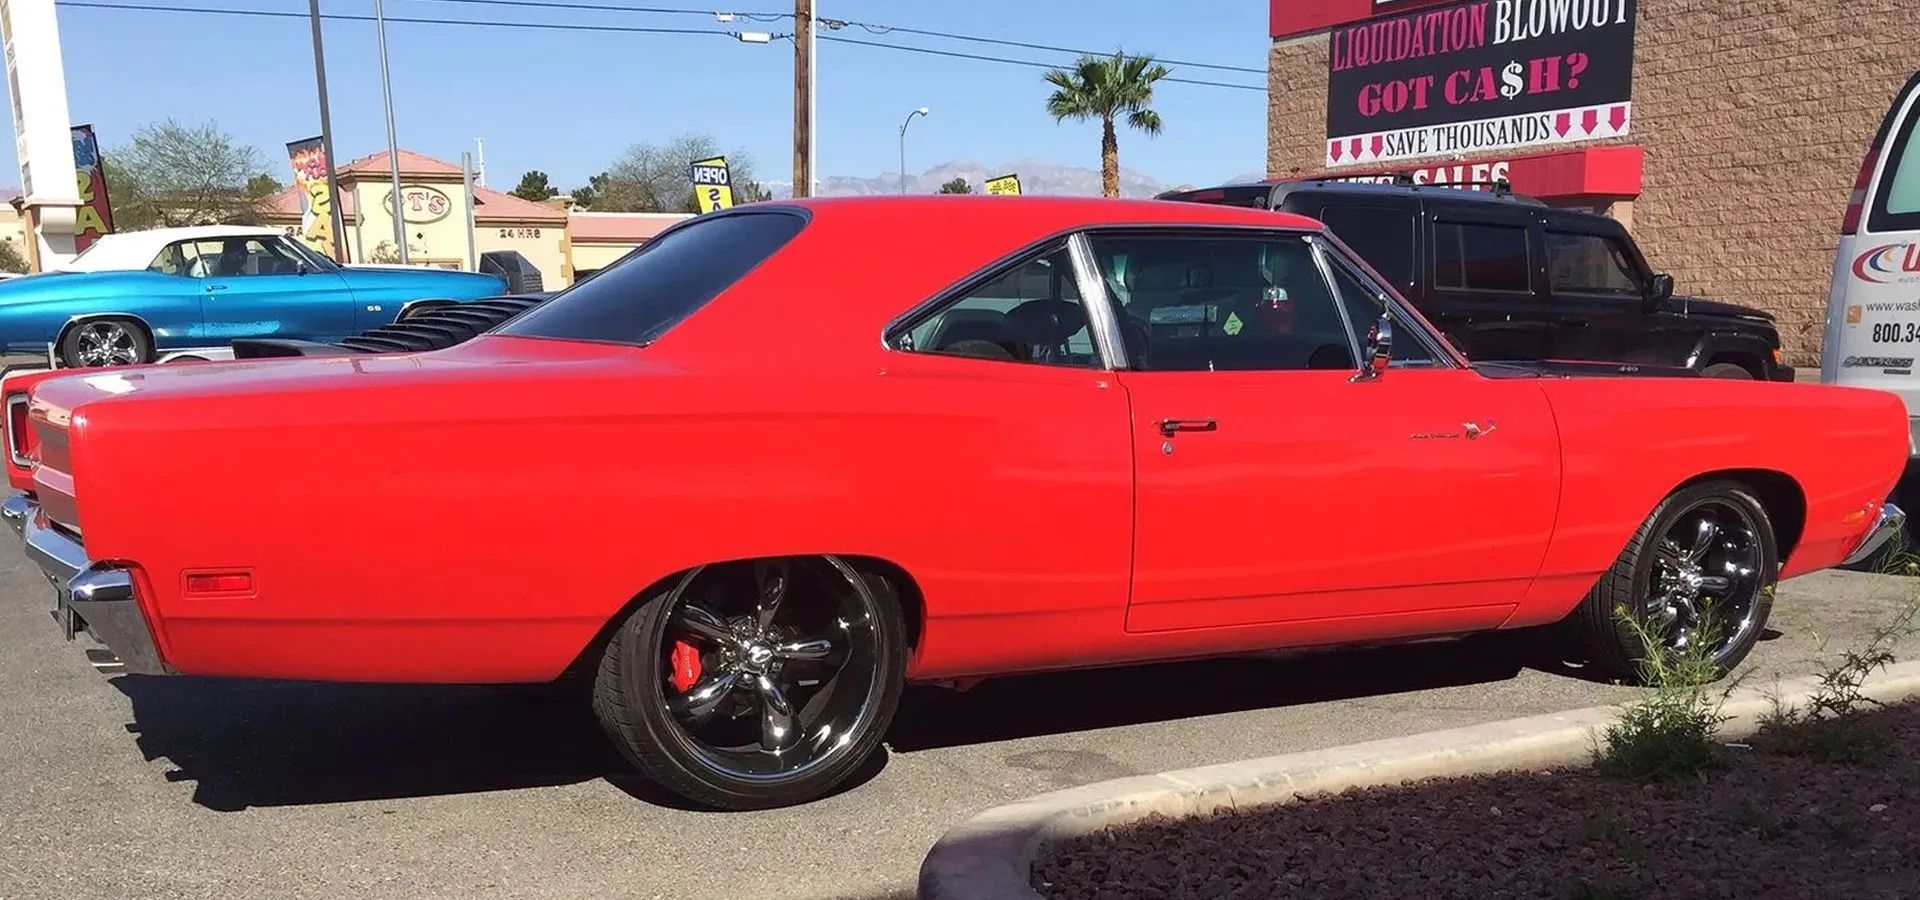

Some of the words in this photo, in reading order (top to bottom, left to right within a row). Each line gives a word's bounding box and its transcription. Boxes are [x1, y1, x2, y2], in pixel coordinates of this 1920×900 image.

[1332, 2, 1488, 72] LIQUIDATION
[1357, 75, 1434, 117] GOT
[1444, 52, 1589, 106] CA$H?
[1385, 130, 1428, 158] SAVE
[1433, 113, 1551, 152] THOUSANDS
[388, 191, 446, 215] T'S
